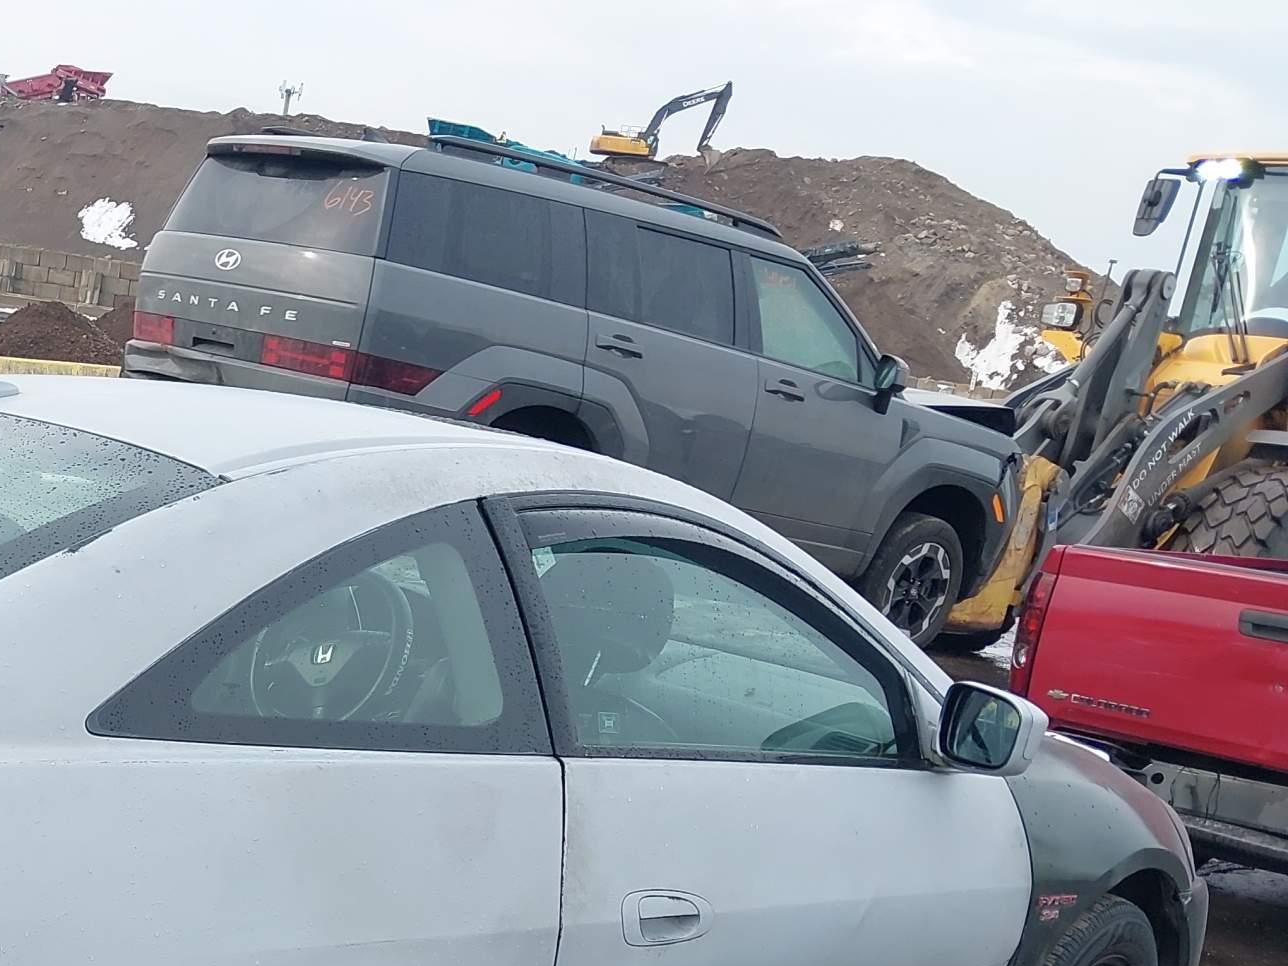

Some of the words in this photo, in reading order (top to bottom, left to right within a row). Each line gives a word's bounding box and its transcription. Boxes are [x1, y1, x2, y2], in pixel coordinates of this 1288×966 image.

[324, 181, 375, 216] 6143
[157, 289, 239, 312] SANTA
[260, 306, 298, 321] FE
[1132, 469, 1147, 490] DO
[1147, 441, 1168, 470] NOT
[1168, 408, 1195, 442] WALK
